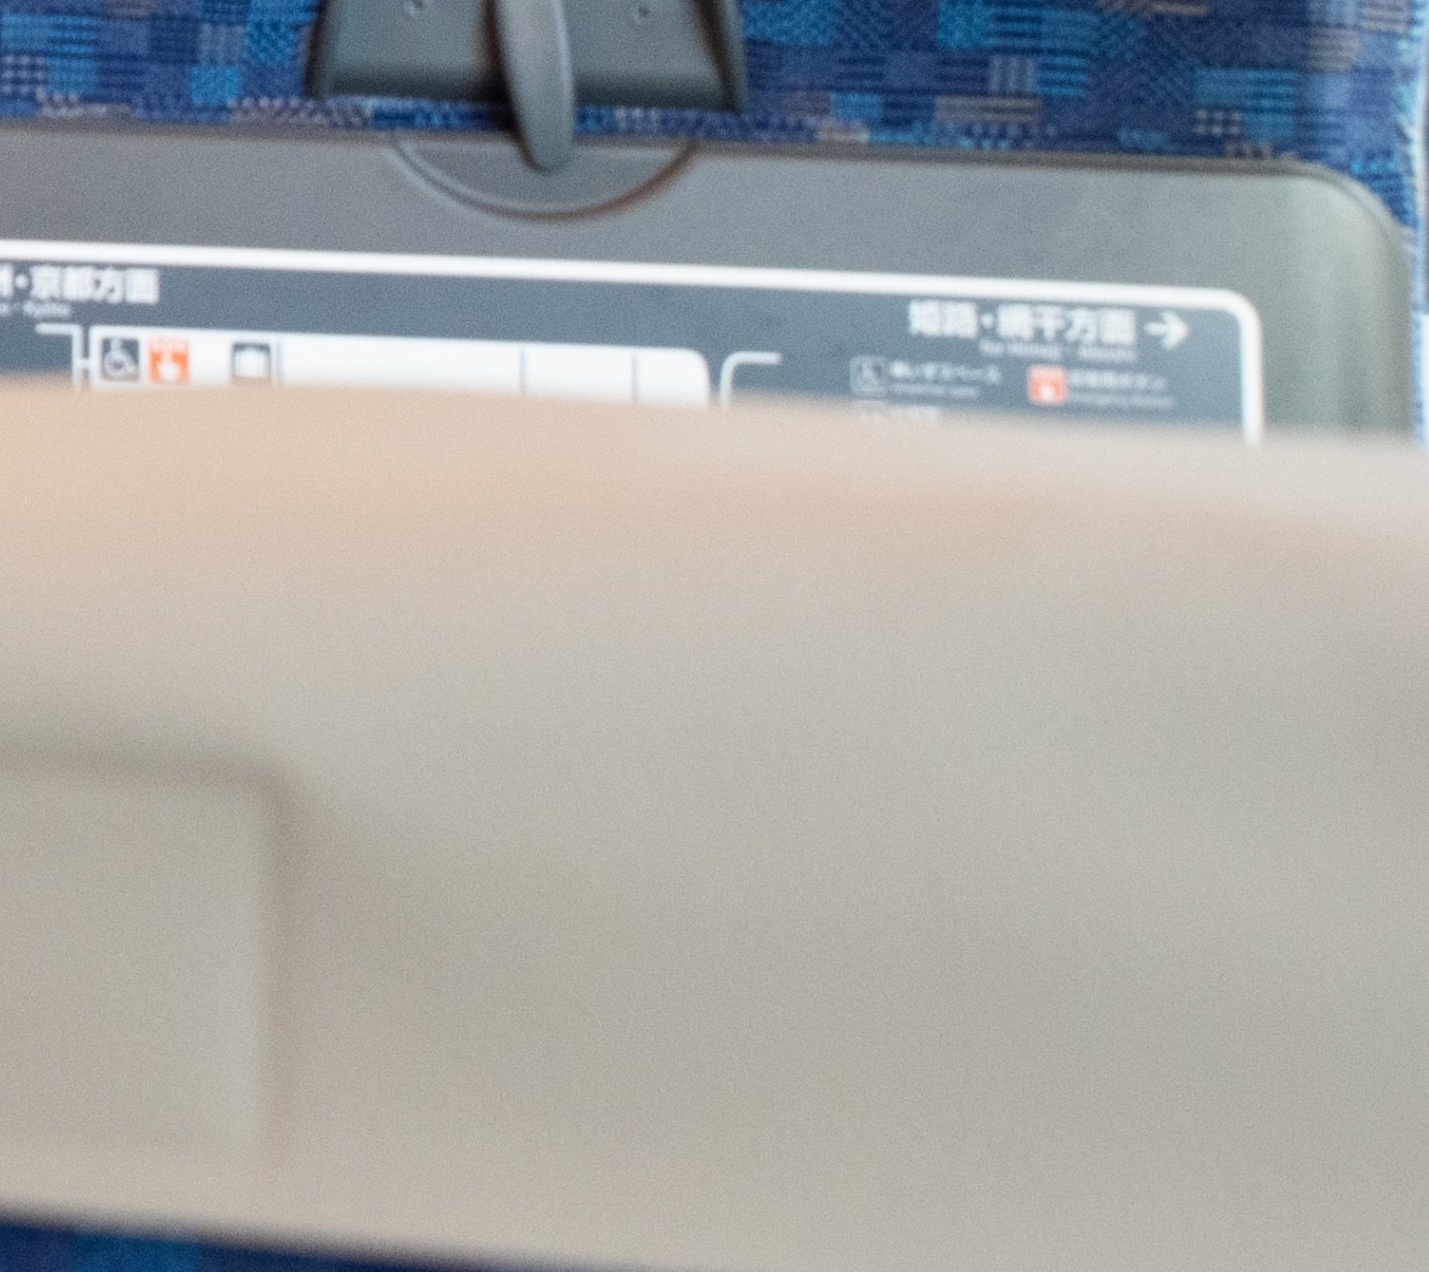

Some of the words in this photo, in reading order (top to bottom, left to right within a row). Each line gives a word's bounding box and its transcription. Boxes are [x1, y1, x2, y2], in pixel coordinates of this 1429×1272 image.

[908, 299, 1135, 345] 姫路・網干方面
